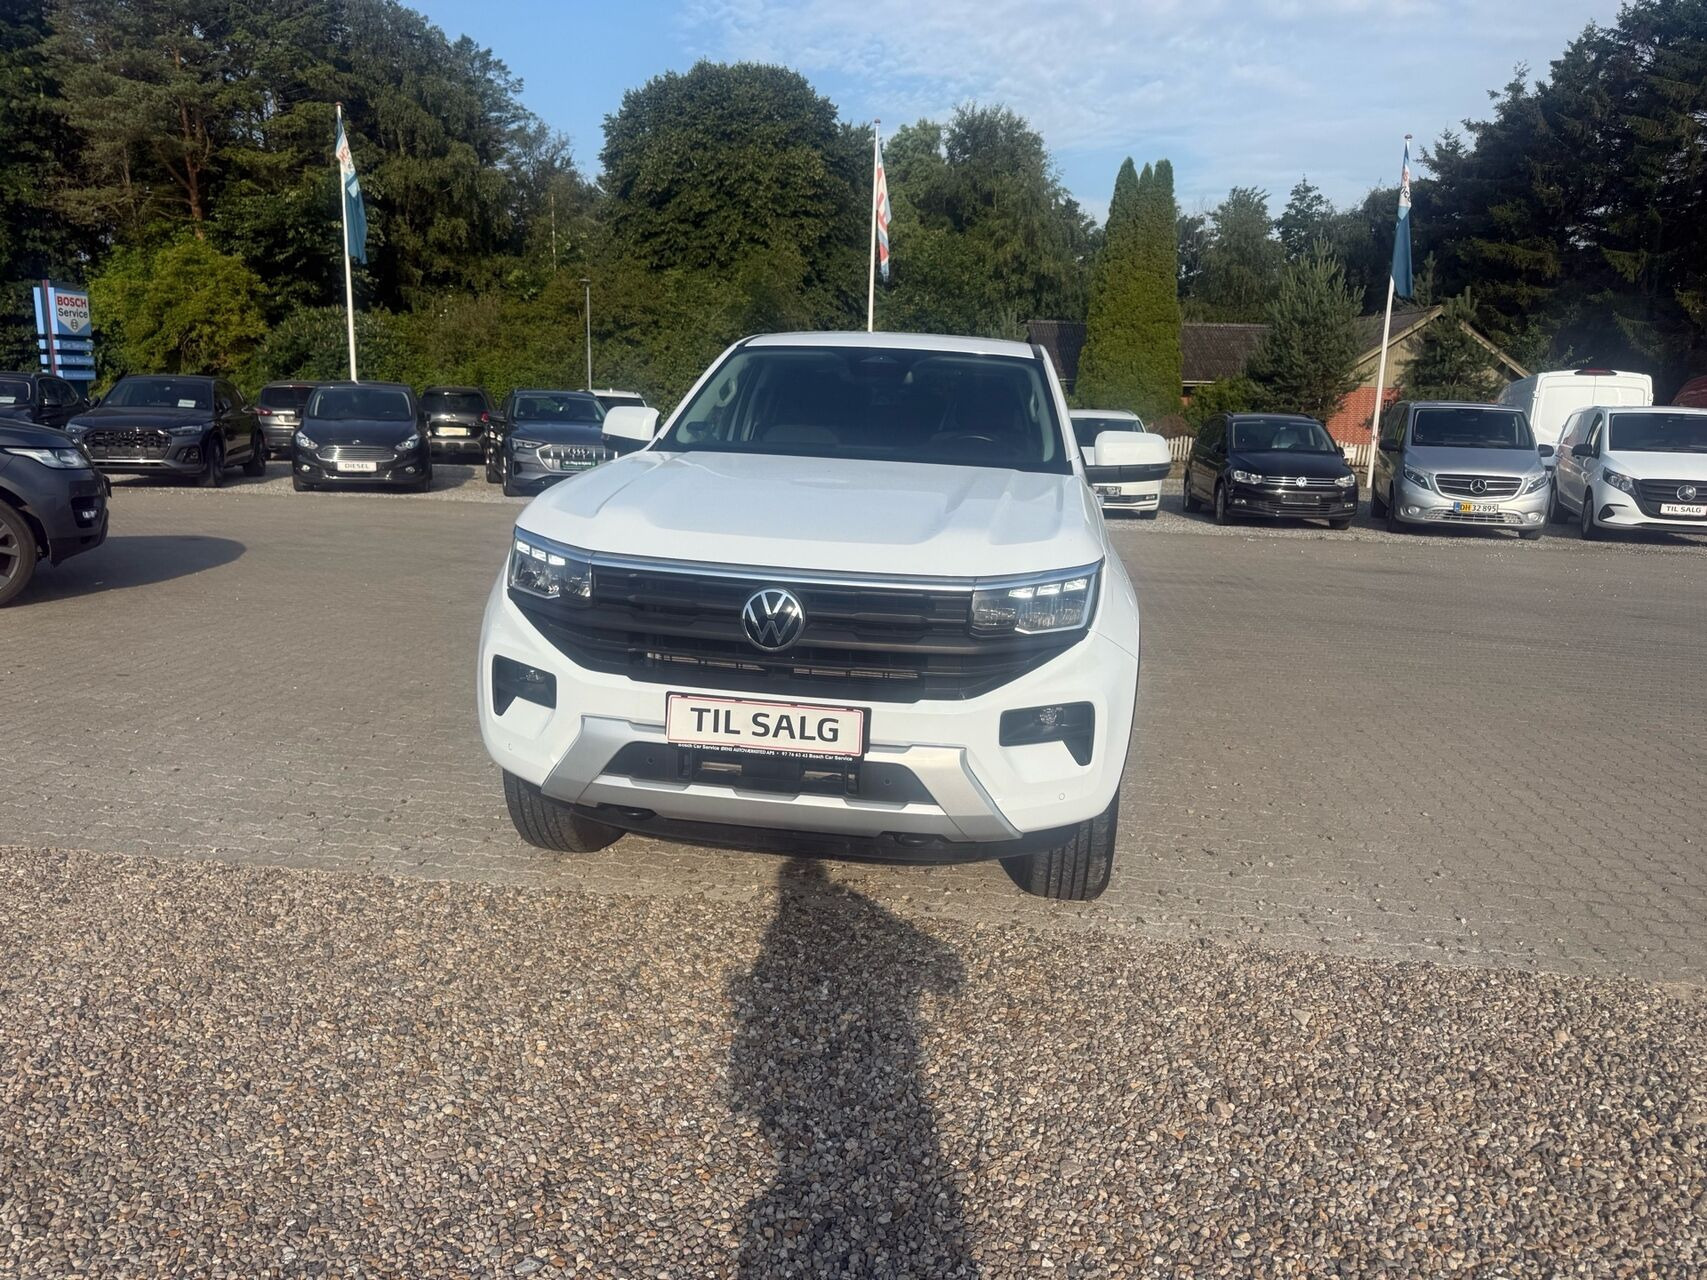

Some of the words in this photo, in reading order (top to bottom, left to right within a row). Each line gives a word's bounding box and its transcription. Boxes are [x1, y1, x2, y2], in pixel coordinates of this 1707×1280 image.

[57, 296, 87, 308] BOSCH
[58, 307, 88, 319] Service
[1460, 504, 1471, 512] DH
[1472, 505, 1481, 513] 32
[1482, 505, 1496, 514] 895
[1667, 505, 1679, 513] TIL
[1680, 506, 1702, 514] SALG
[690, 707, 741, 735] TIL
[751, 712, 839, 742] SALG
